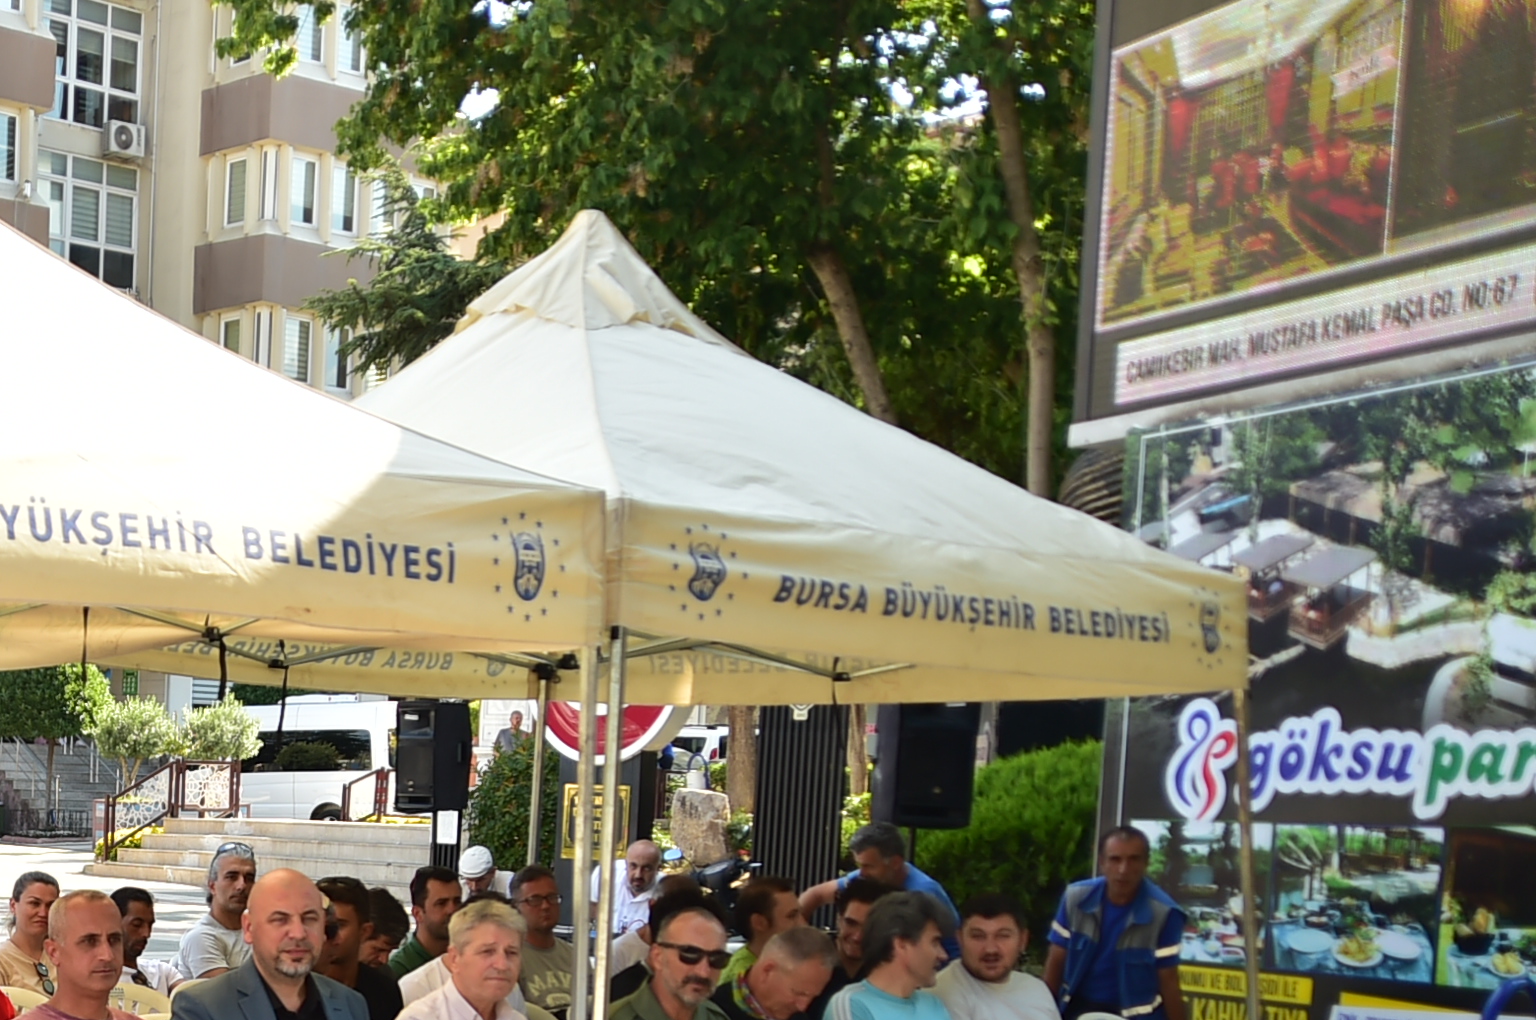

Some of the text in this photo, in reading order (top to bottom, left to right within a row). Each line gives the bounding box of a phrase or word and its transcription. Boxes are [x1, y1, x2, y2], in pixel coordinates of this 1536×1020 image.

[1246, 318, 1318, 358] MUSTAFA
[1320, 306, 1377, 342] KEMAL
[241, 525, 457, 585] BELEDİYESİ
[772, 574, 1171, 645] BURSA BÜYÜKŞEHİR BELEDİYESİ
